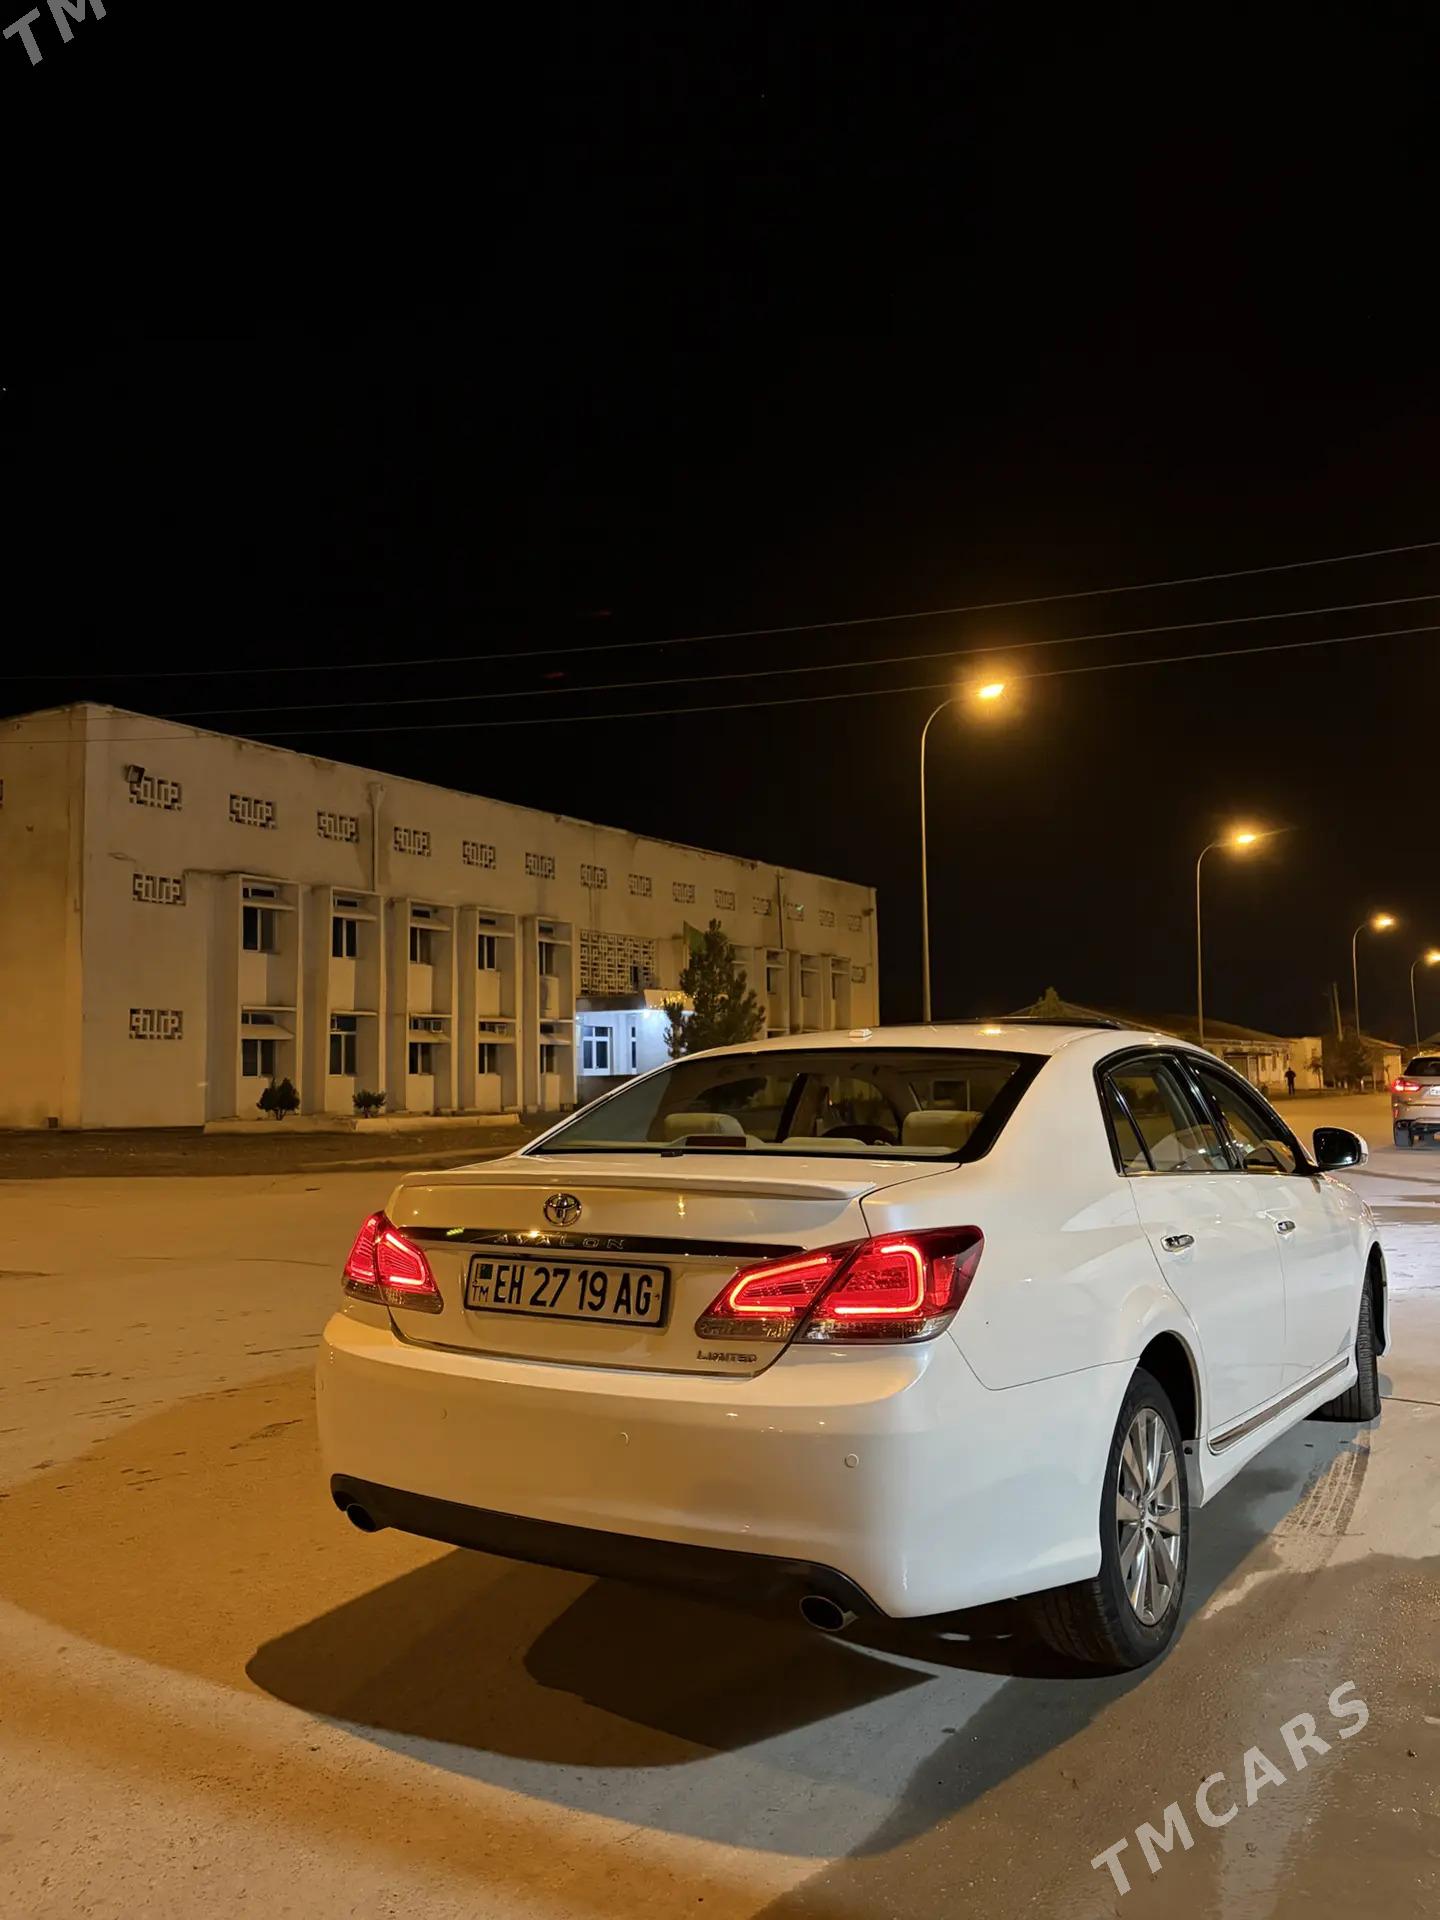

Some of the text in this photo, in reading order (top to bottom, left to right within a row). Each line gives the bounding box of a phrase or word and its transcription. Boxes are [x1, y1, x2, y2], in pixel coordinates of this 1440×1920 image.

[493, 1233, 626, 1250] AVALON
[472, 1284, 489, 1302] TM
[493, 1264, 653, 1316] EH 27 19 AG
